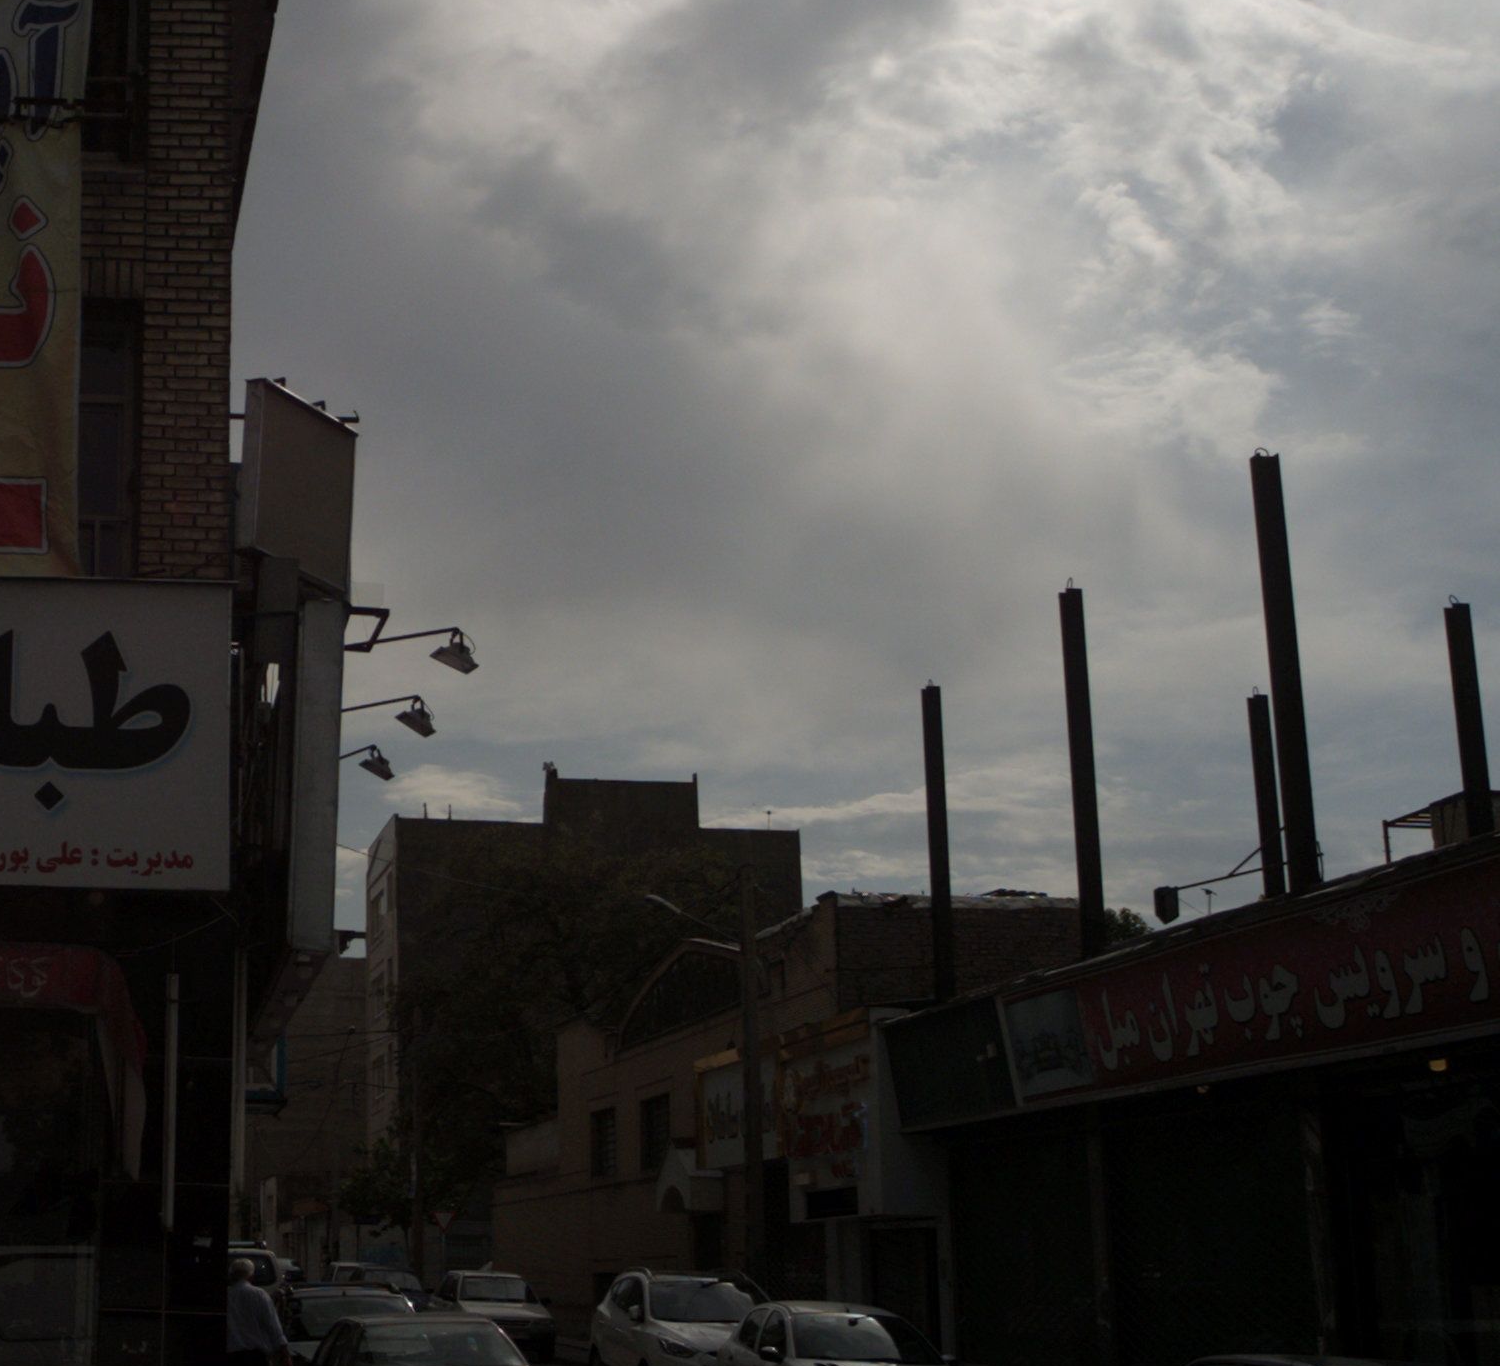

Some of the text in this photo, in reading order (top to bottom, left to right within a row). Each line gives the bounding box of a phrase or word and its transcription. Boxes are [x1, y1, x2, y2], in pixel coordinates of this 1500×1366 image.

[36, 841, 83, 874] علی
[1147, 962, 1220, 1063] تهران
[1223, 963, 1304, 1042] چوب
[1314, 933, 1448, 1030] سرویس
[1099, 987, 1142, 1071] مبل
